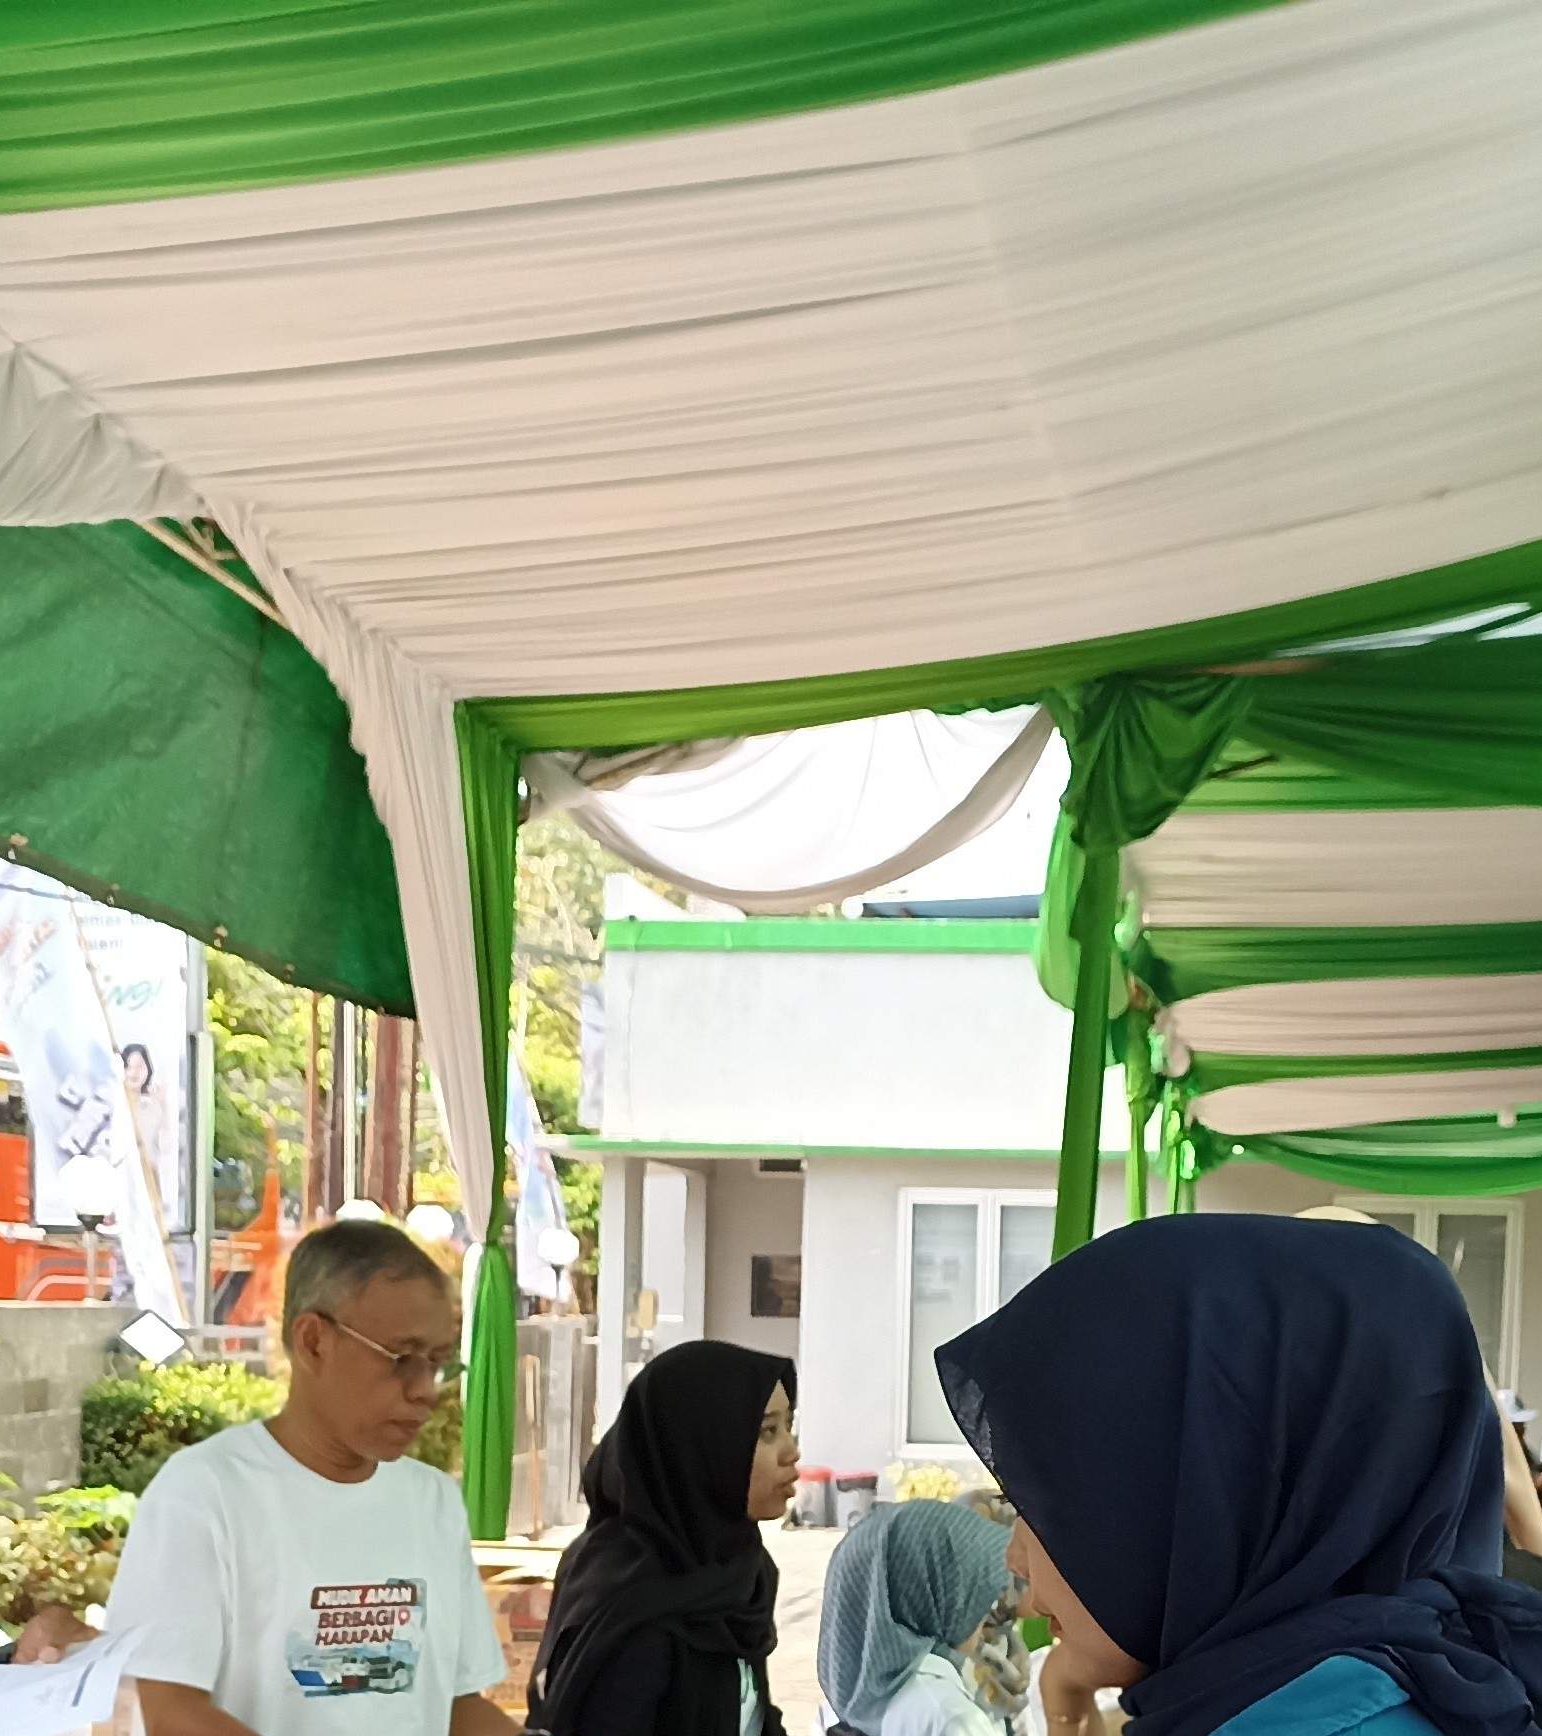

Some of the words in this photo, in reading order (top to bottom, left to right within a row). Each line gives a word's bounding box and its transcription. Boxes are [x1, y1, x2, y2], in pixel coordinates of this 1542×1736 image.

[364, 1586, 412, 1604] AMAN
[318, 1608, 396, 1628] BERBAGI
[315, 1628, 394, 1645] HARAPAN
